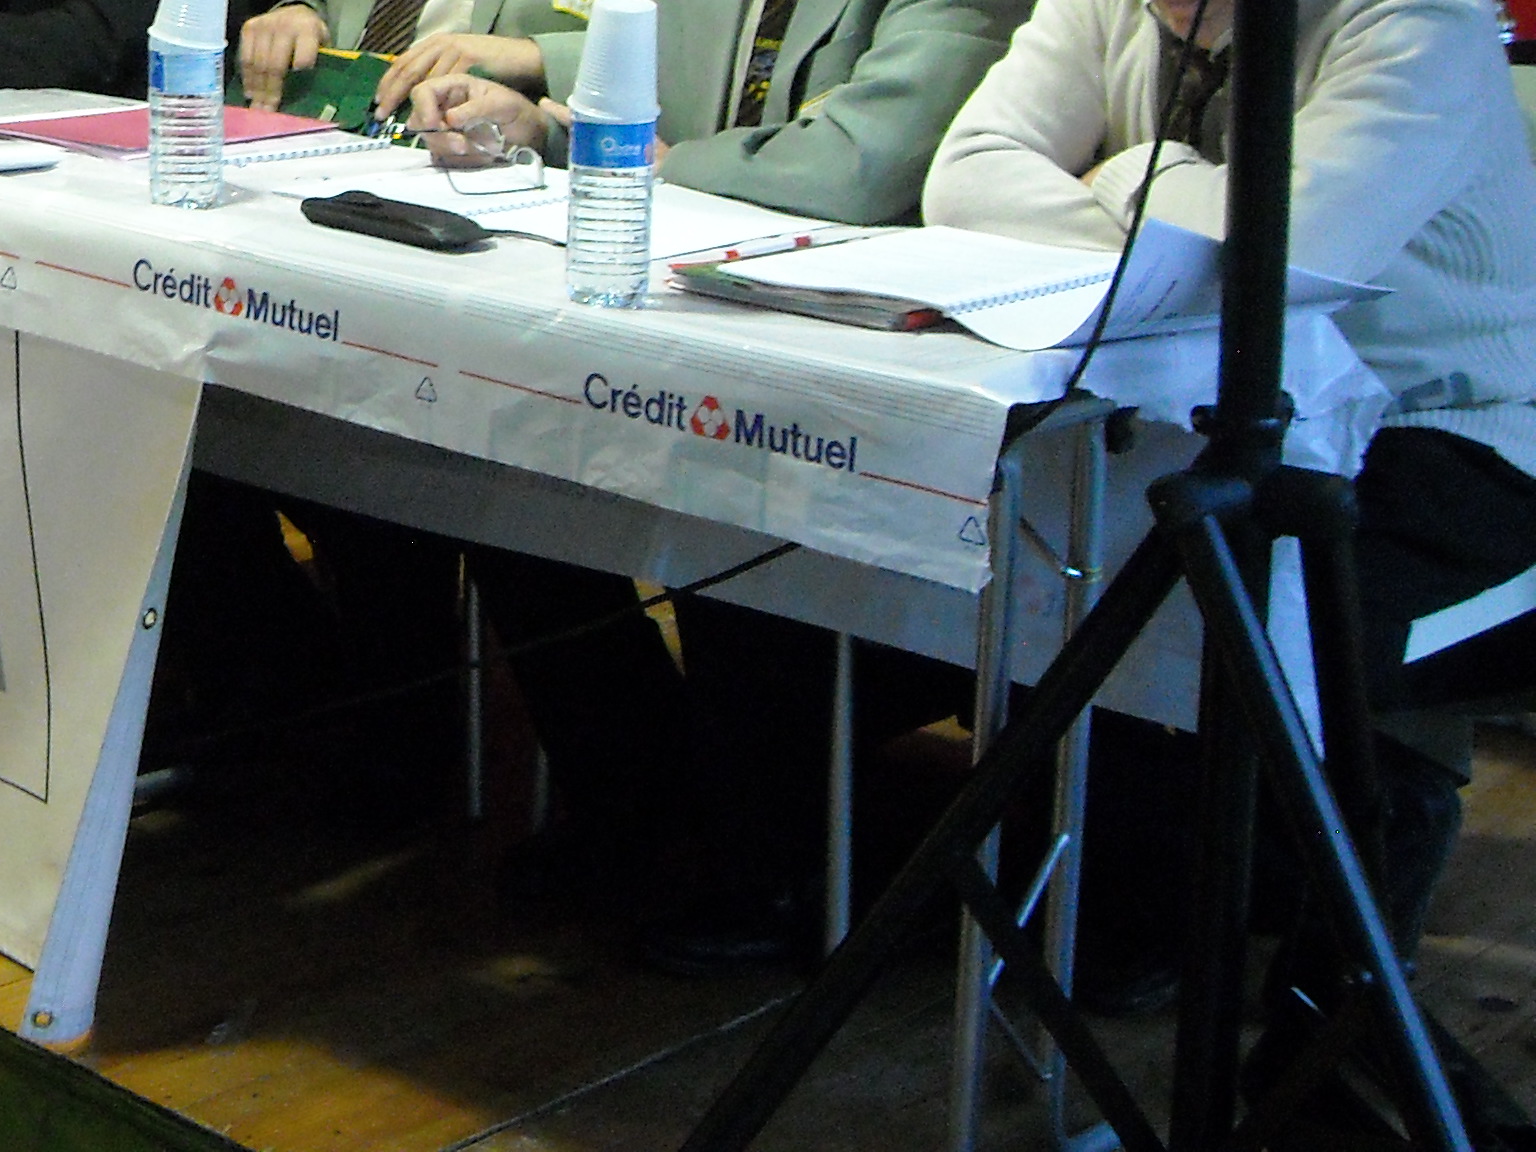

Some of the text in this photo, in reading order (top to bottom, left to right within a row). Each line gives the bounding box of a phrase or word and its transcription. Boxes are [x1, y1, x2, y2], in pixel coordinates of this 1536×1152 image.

[132, 258, 340, 343] Crédit Mutuel
[583, 372, 858, 472] Crédit Mutuel
